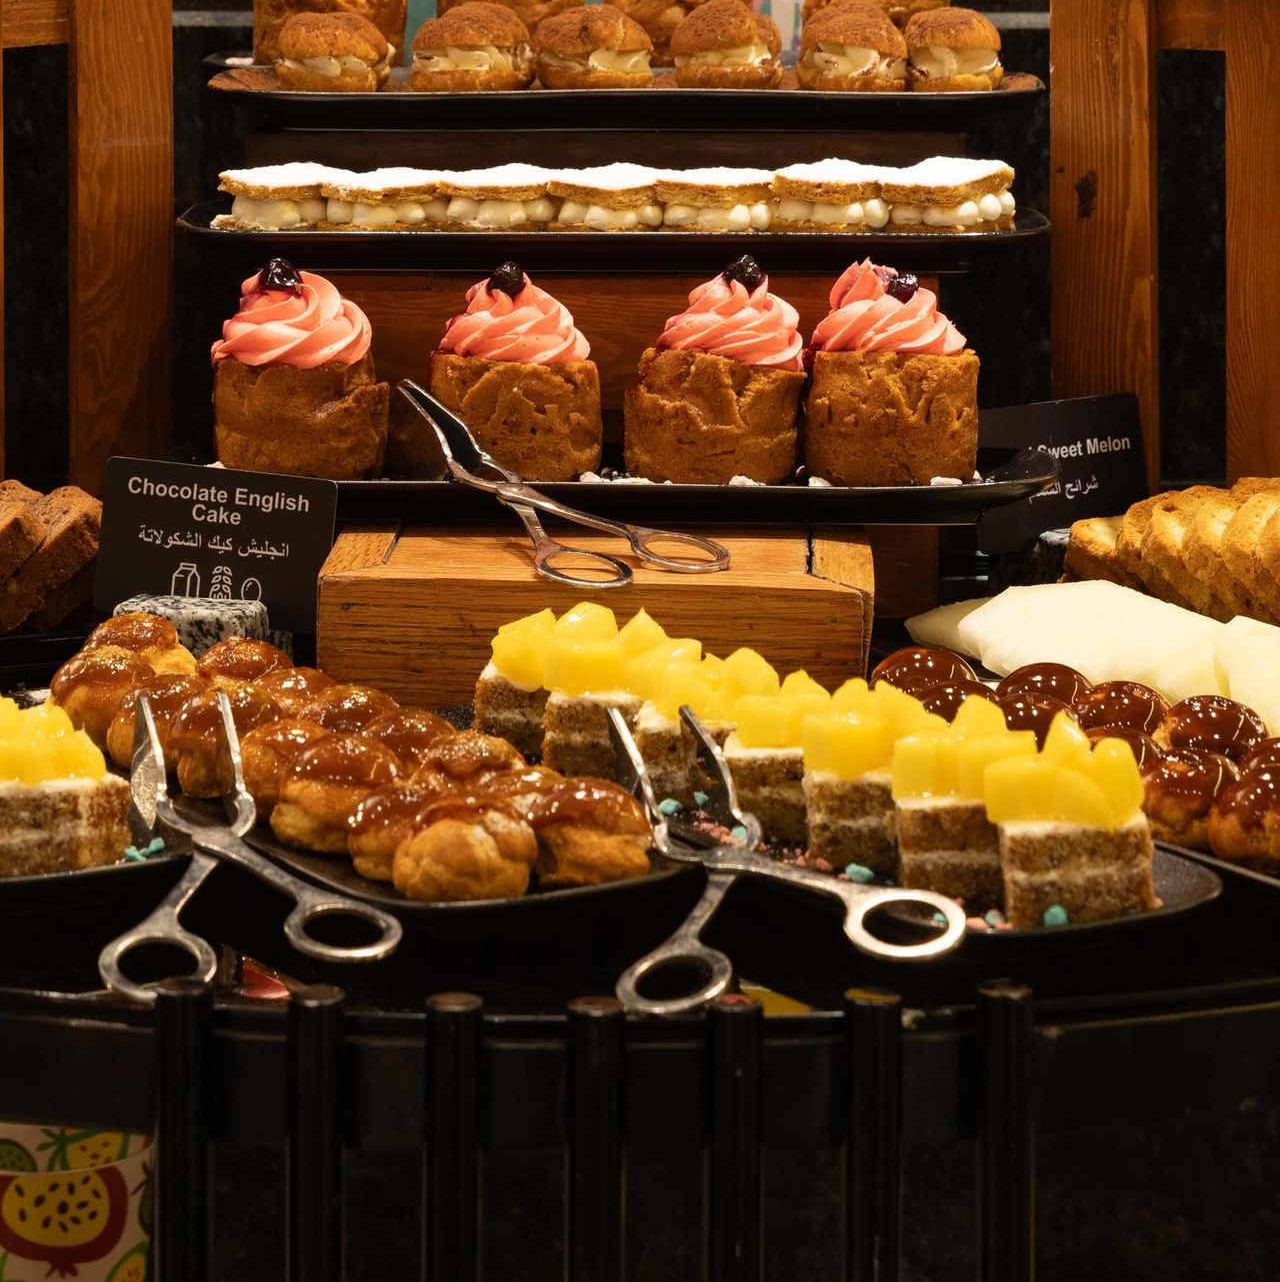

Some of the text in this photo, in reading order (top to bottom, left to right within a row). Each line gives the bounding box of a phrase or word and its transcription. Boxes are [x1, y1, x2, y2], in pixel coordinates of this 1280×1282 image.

[1086, 436, 1131, 455] Melon
[127, 476, 310, 513] Chocolate English
[192, 504, 242, 526] Cake
[138, 524, 290, 560] انجليش كيك الشكولاتة
